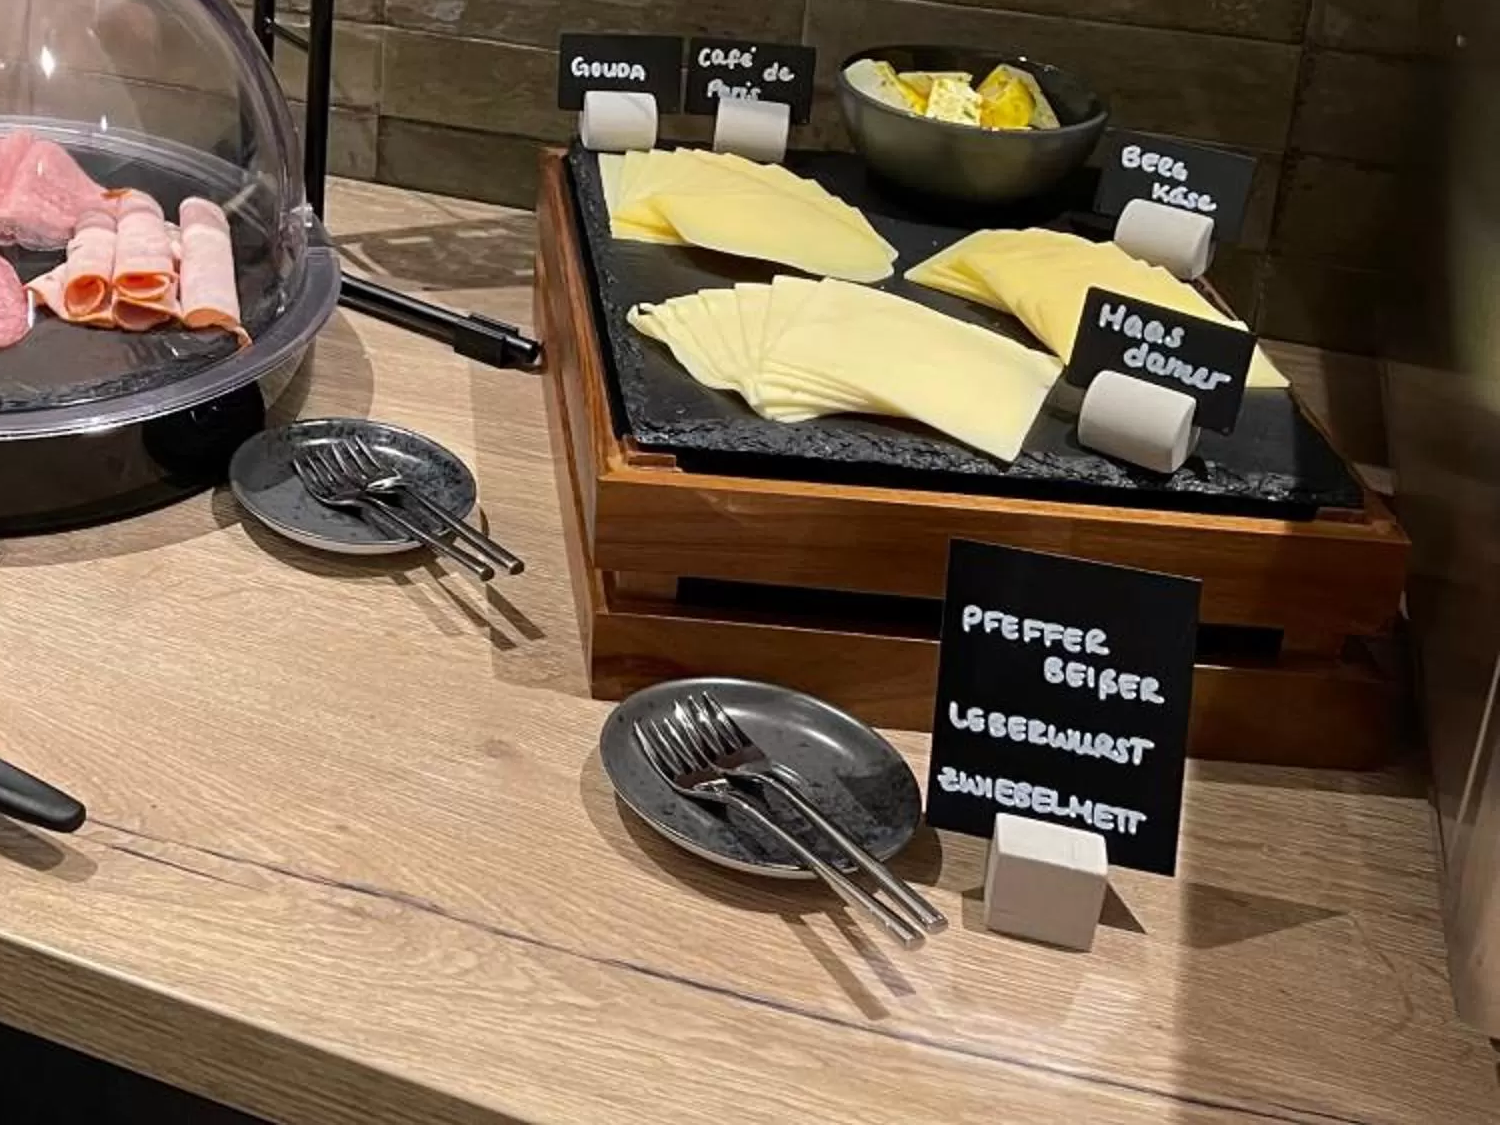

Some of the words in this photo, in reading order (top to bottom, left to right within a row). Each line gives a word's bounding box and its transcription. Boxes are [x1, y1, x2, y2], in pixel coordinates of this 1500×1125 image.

[763, 62, 795, 82] de
[961, 604, 1110, 656] PFEFFER
[948, 700, 1155, 766] LEBERWURST
[937, 766, 1148, 833] ZWIEBELMETT
